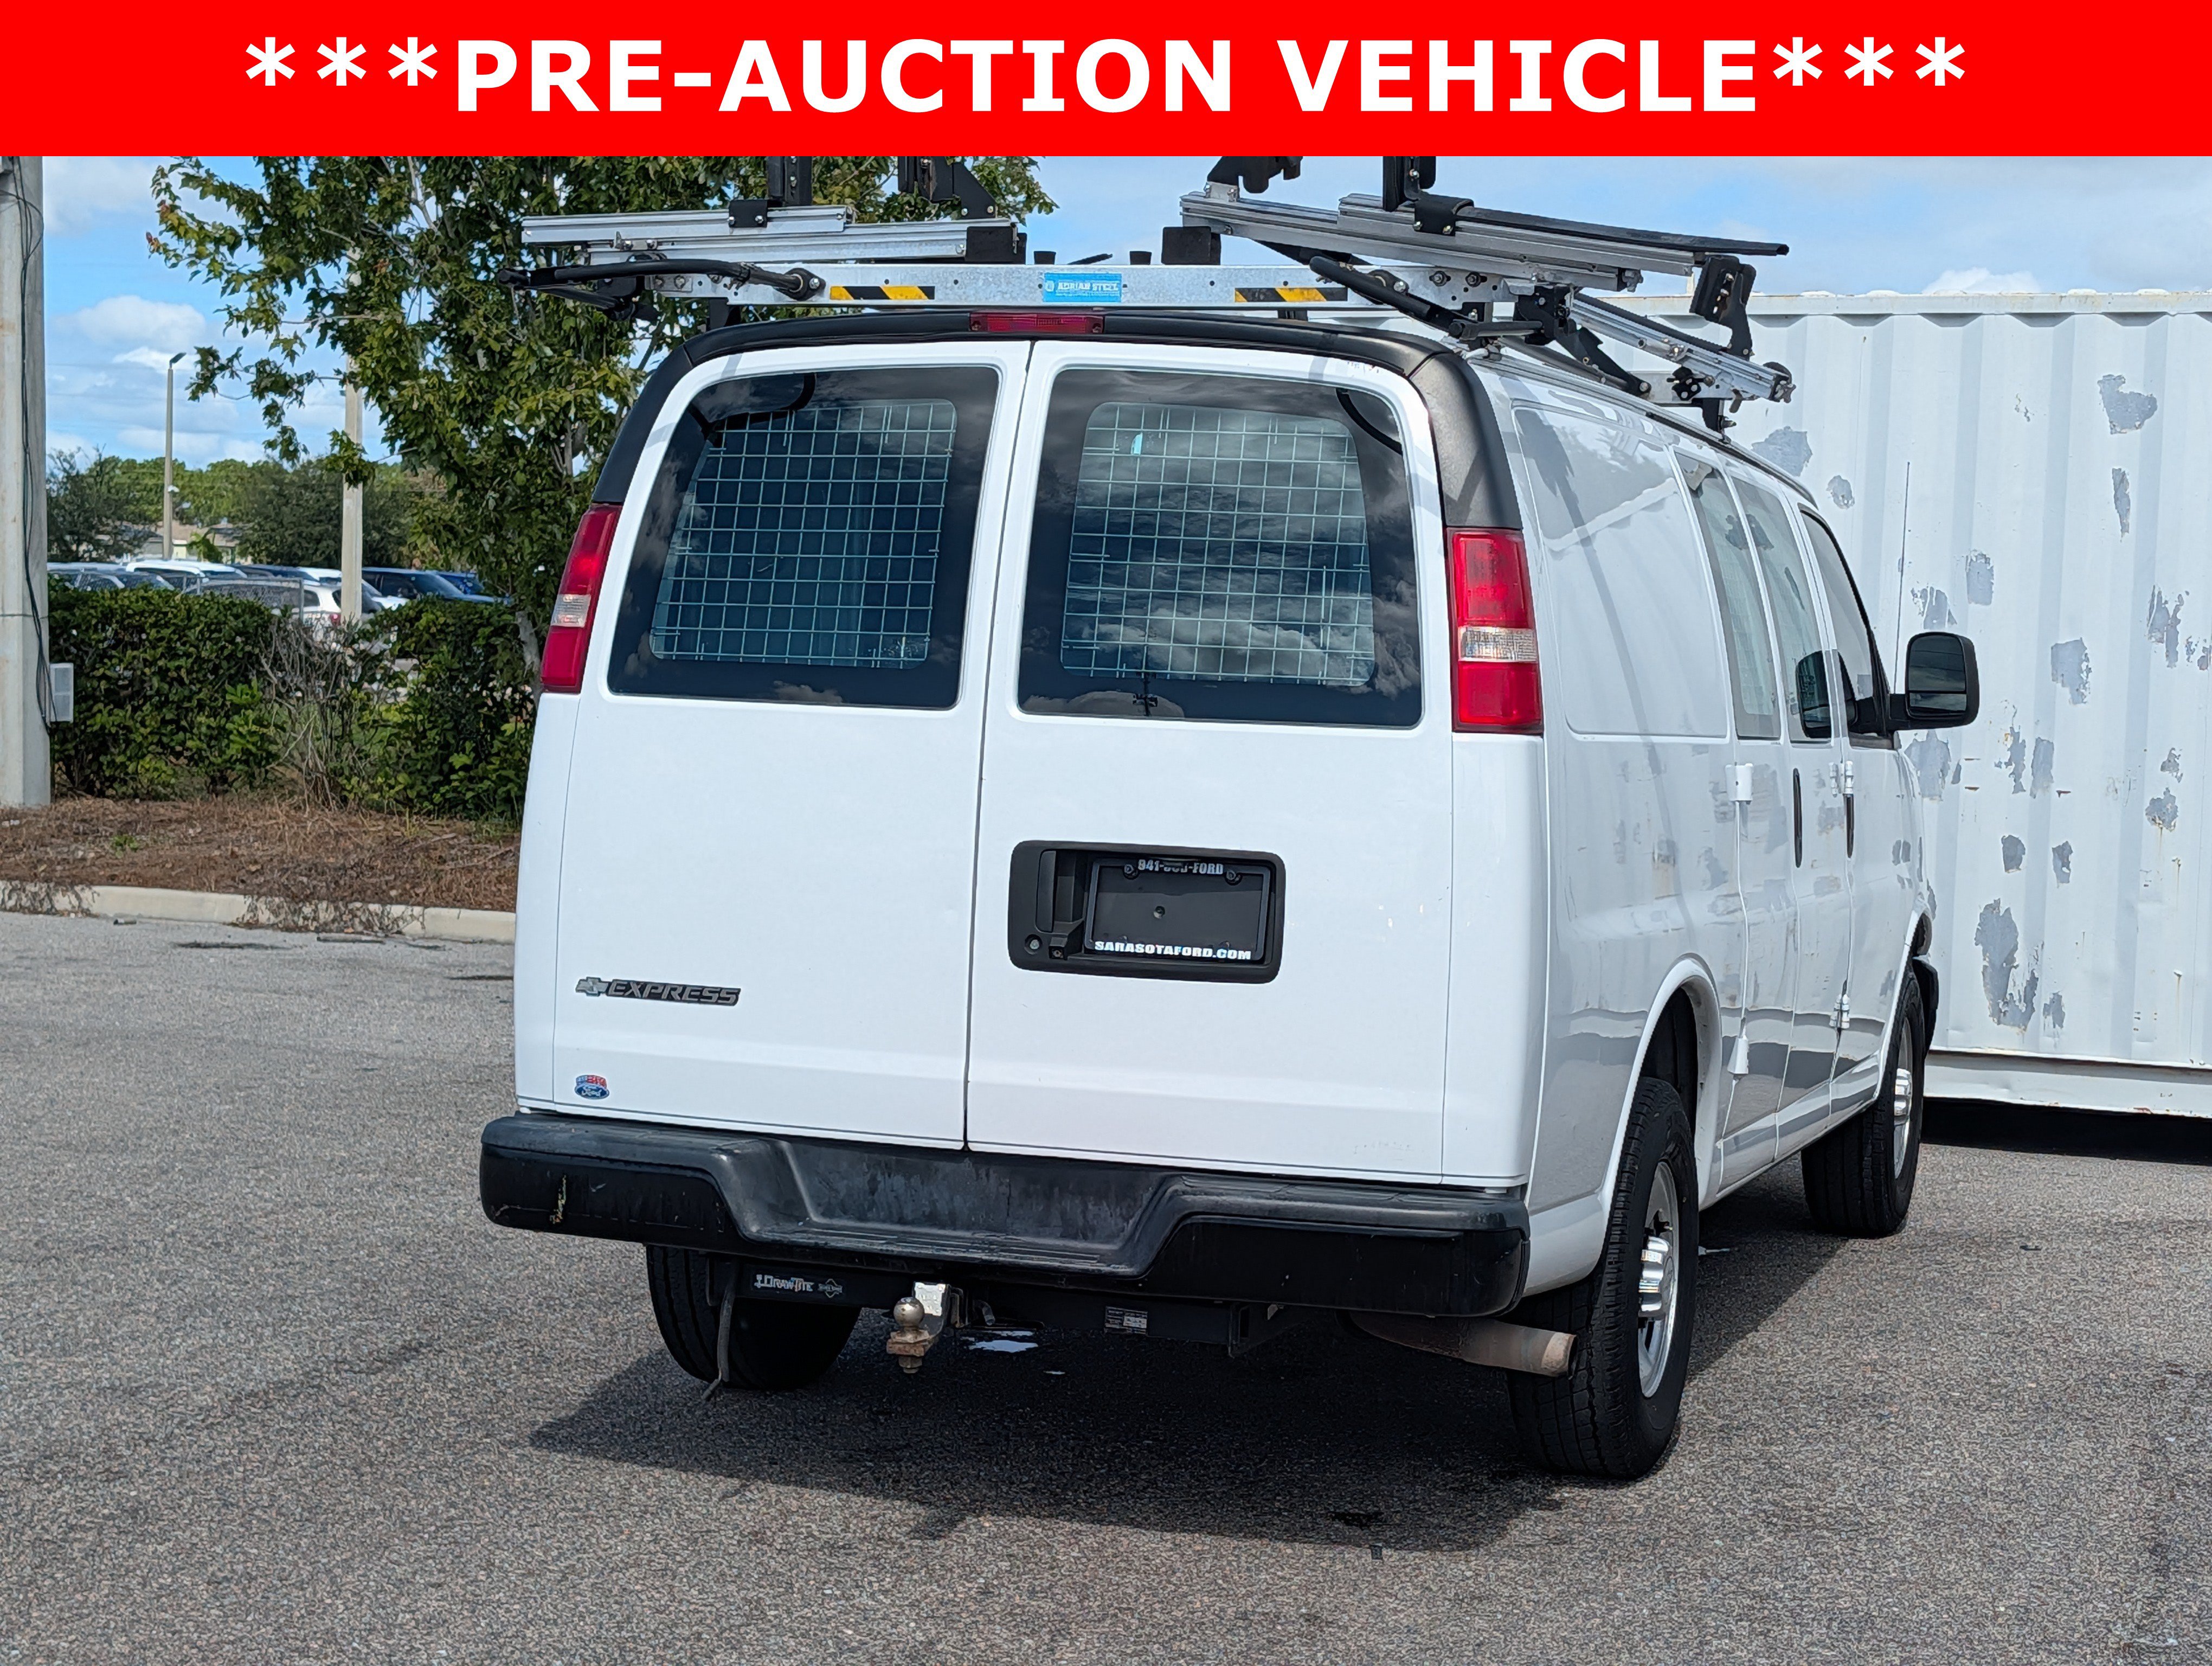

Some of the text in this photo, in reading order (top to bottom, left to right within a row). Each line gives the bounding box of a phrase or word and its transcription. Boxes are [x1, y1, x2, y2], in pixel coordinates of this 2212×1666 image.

[1058, 281, 1118, 291] ADRIAN STEEL
[1095, 941, 1251, 960] SARASOTAFORD.COM
[608, 980, 739, 1004] EXPRESS
